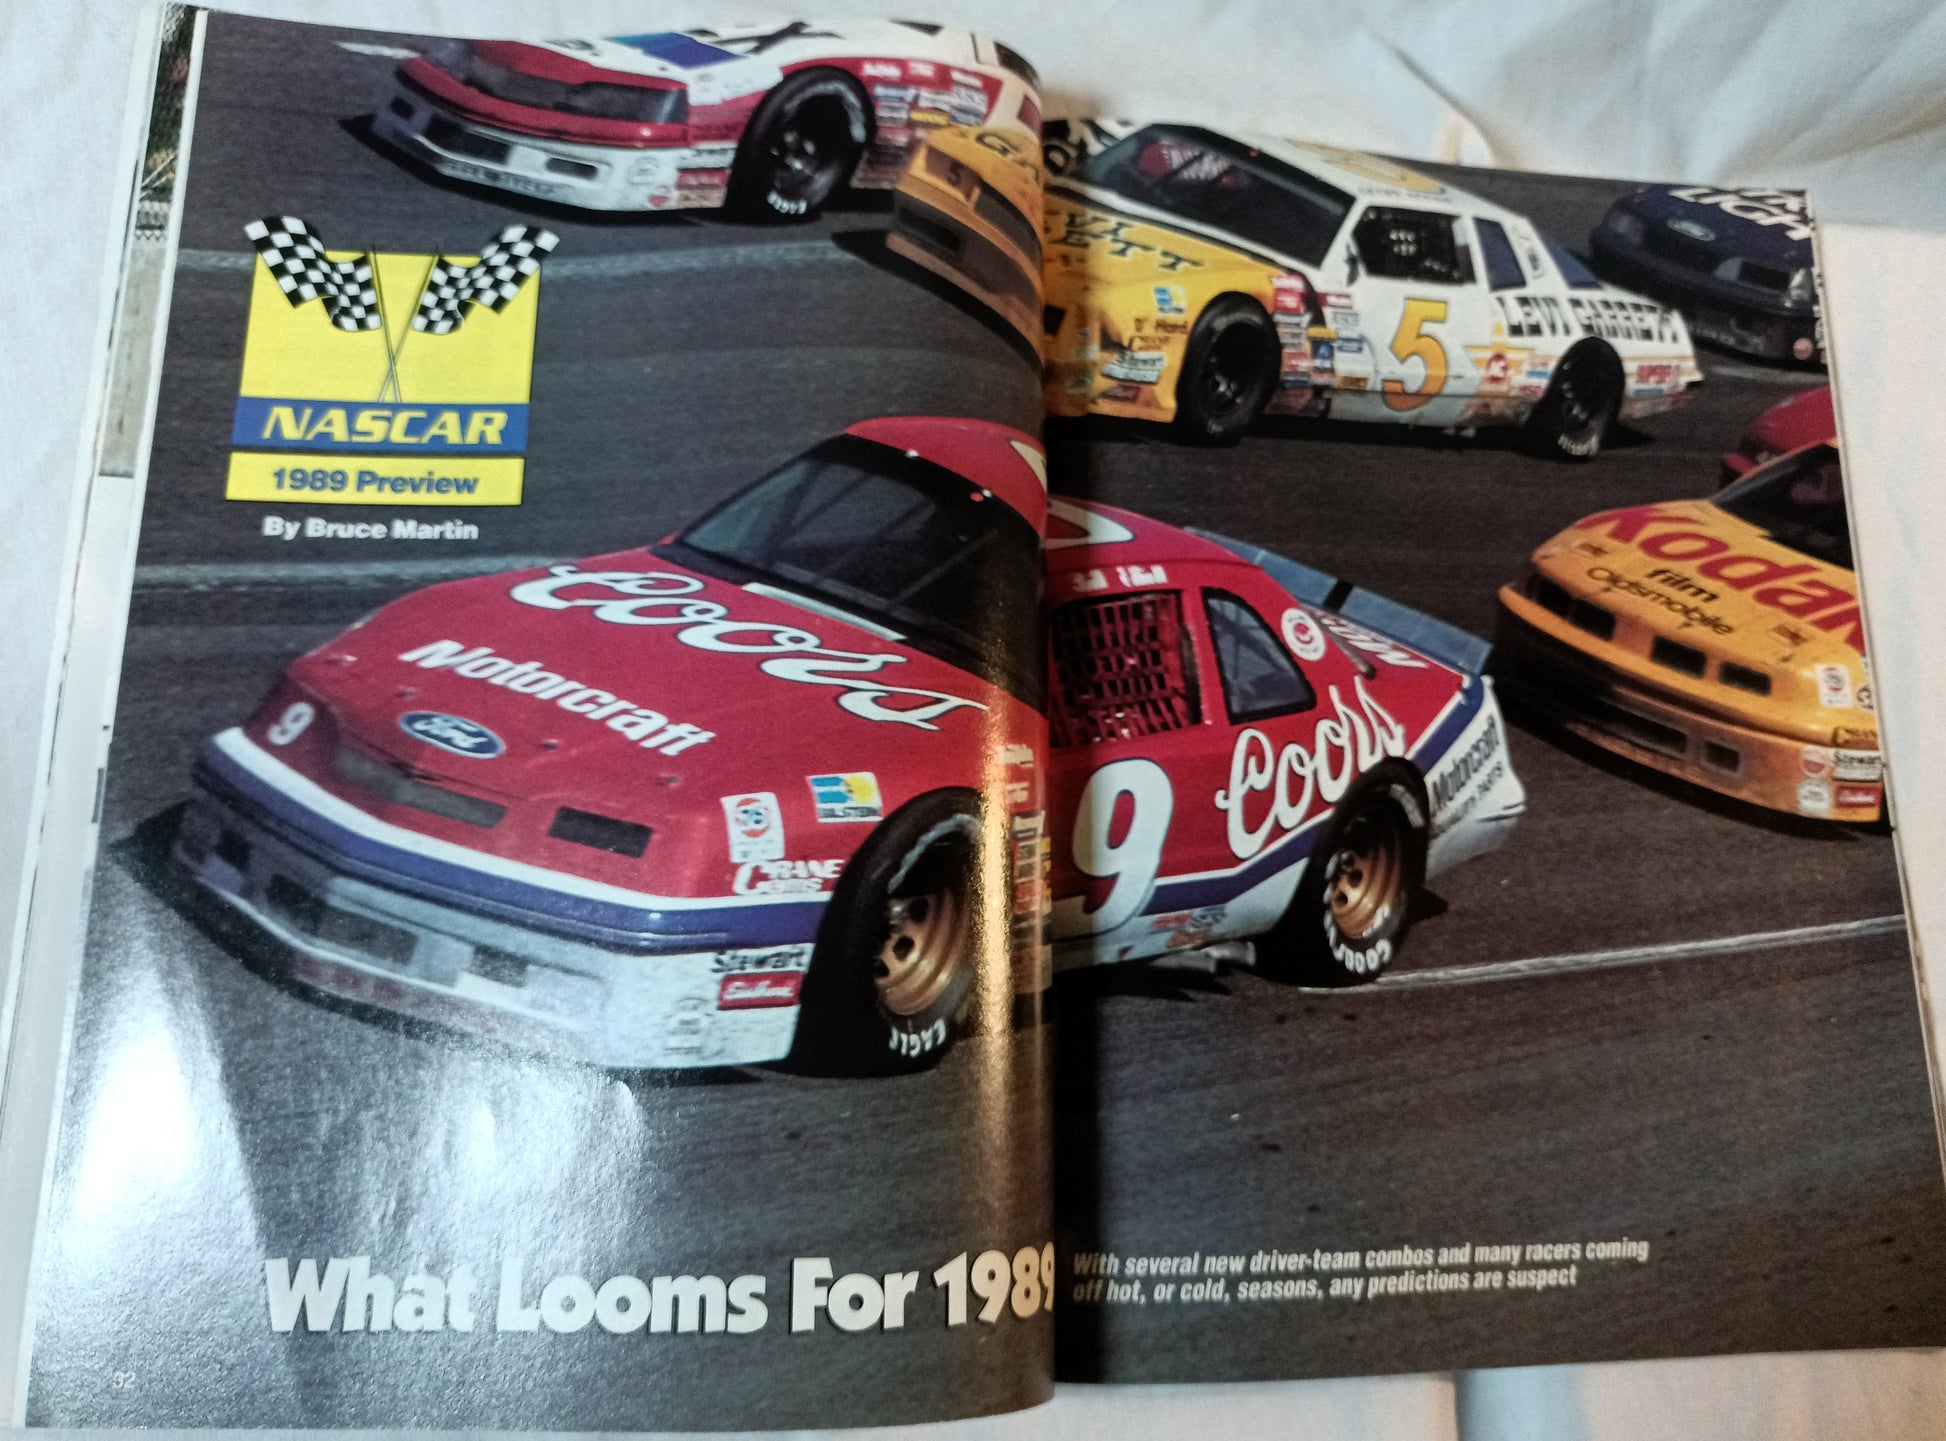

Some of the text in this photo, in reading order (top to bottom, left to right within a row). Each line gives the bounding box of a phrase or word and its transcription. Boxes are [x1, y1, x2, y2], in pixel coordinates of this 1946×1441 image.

[1382, 297, 1449, 411] 5
[262, 405, 508, 445] NASCAR
[272, 468, 479, 495] 1989 Preview
[262, 516, 479, 541] By Bruce Martin
[1587, 566, 1734, 635] Oldsmobile
[1647, 568, 1719, 603] film
[509, 564, 989, 731] Coors
[267, 701, 315, 745] 9
[399, 638, 716, 756] Motorcraft
[1215, 675, 1405, 860] Coors
[1073, 757, 1174, 933] 9
[1072, 1263, 1577, 1304] off hot, or cold, seasons, any predictions are suspect
[1073, 1236, 1649, 1276] With several new driver-team combos and many racers coming
[264, 1241, 1055, 1334] What Looms For 1989
